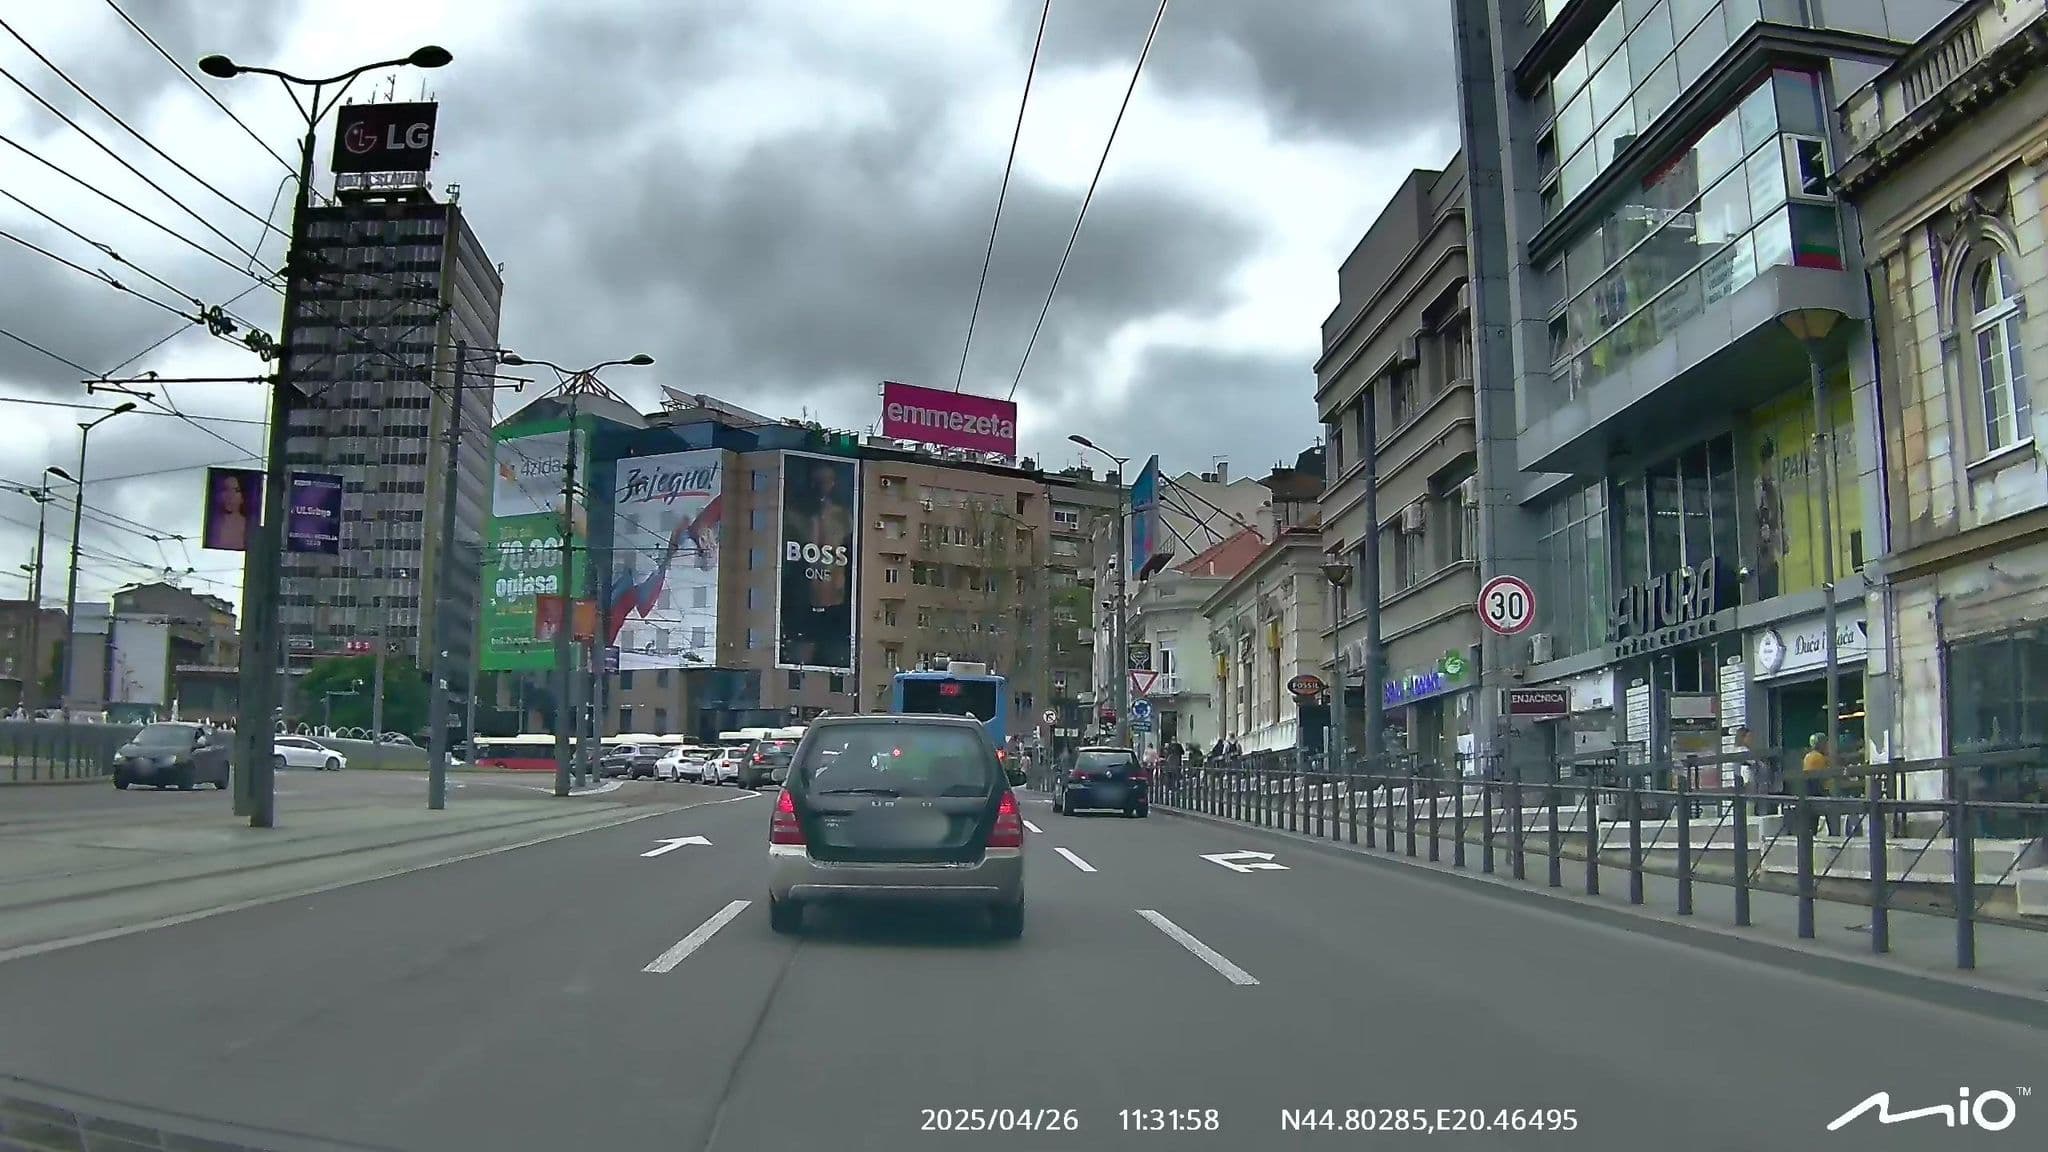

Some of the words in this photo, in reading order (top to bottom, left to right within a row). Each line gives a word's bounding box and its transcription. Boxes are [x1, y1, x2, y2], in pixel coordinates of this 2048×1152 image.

[386, 122, 430, 149] LG
[887, 402, 1014, 439] emmezeta
[786, 541, 848, 567] BOSS
[805, 567, 832, 581] ONE
[1491, 591, 1523, 621] 30
[1612, 557, 1715, 642] FUTURA
[1292, 682, 1320, 690] FOSSIL
